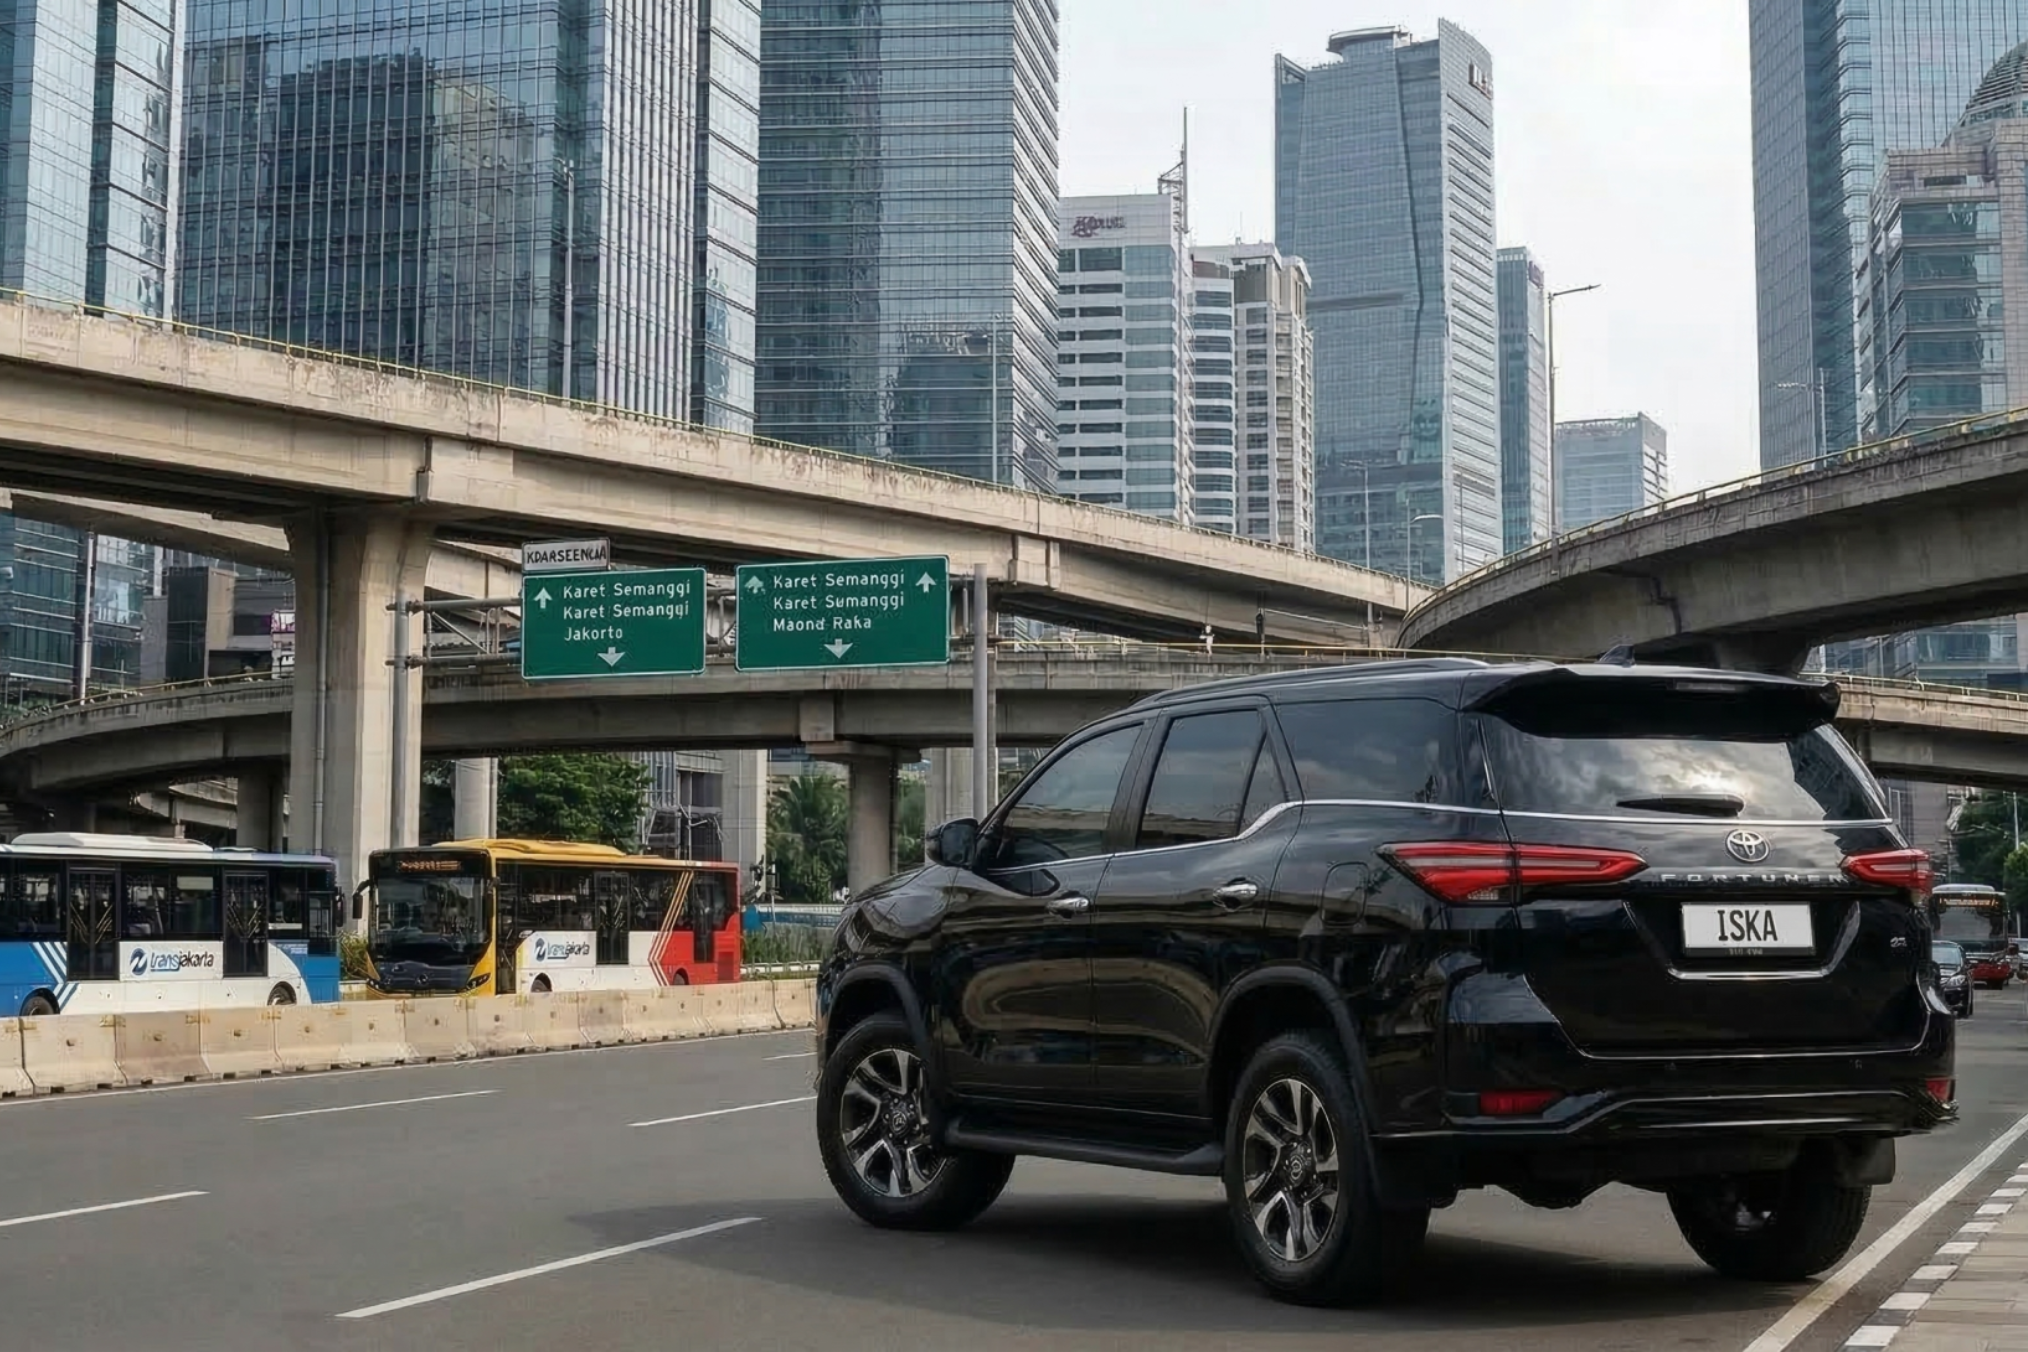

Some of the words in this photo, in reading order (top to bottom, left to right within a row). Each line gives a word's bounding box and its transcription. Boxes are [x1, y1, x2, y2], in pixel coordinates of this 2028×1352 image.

[773, 574, 817, 588] Karet
[825, 569, 905, 589] Semanggi
[563, 584, 606, 599] Karet
[773, 595, 817, 610] Karet
[563, 605, 605, 620] Karet
[1717, 910, 1778, 942] ISKA
